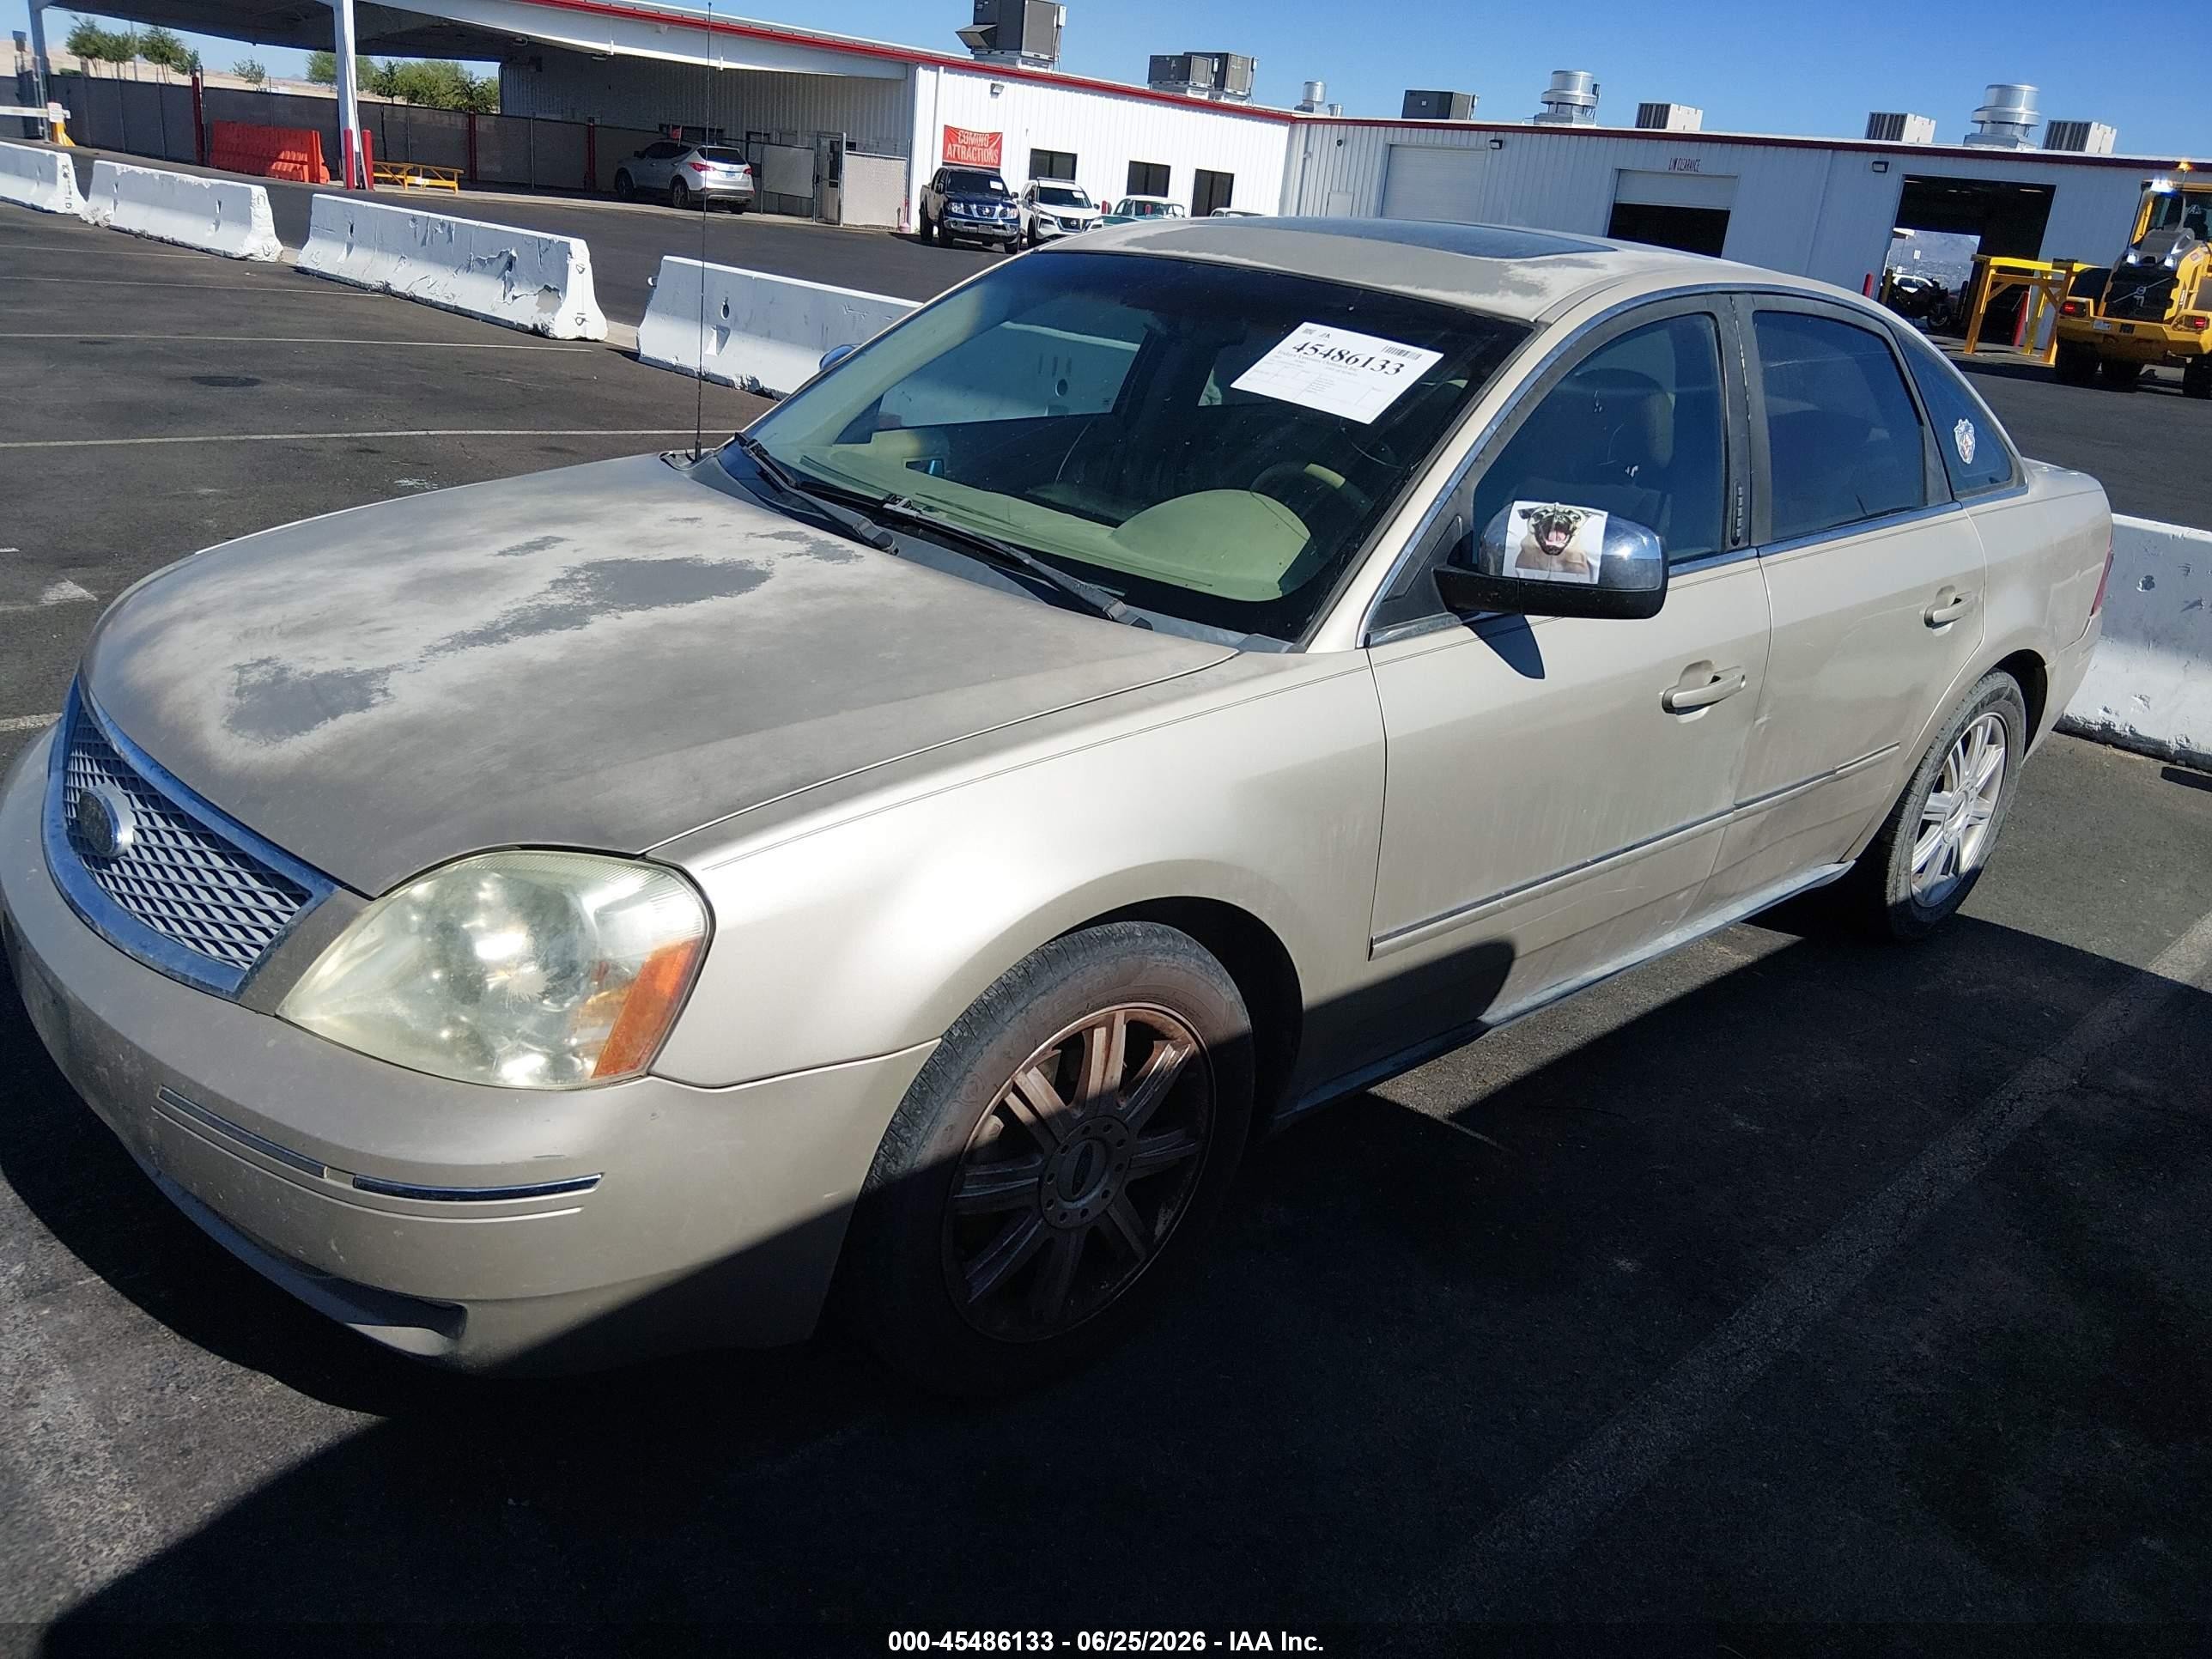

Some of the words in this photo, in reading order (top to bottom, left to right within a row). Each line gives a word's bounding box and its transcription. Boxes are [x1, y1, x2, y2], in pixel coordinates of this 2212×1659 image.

[957, 130, 990, 148] COMING
[946, 143, 999, 164] ATTRACTIONS
[1291, 341, 1405, 375] 45486133
